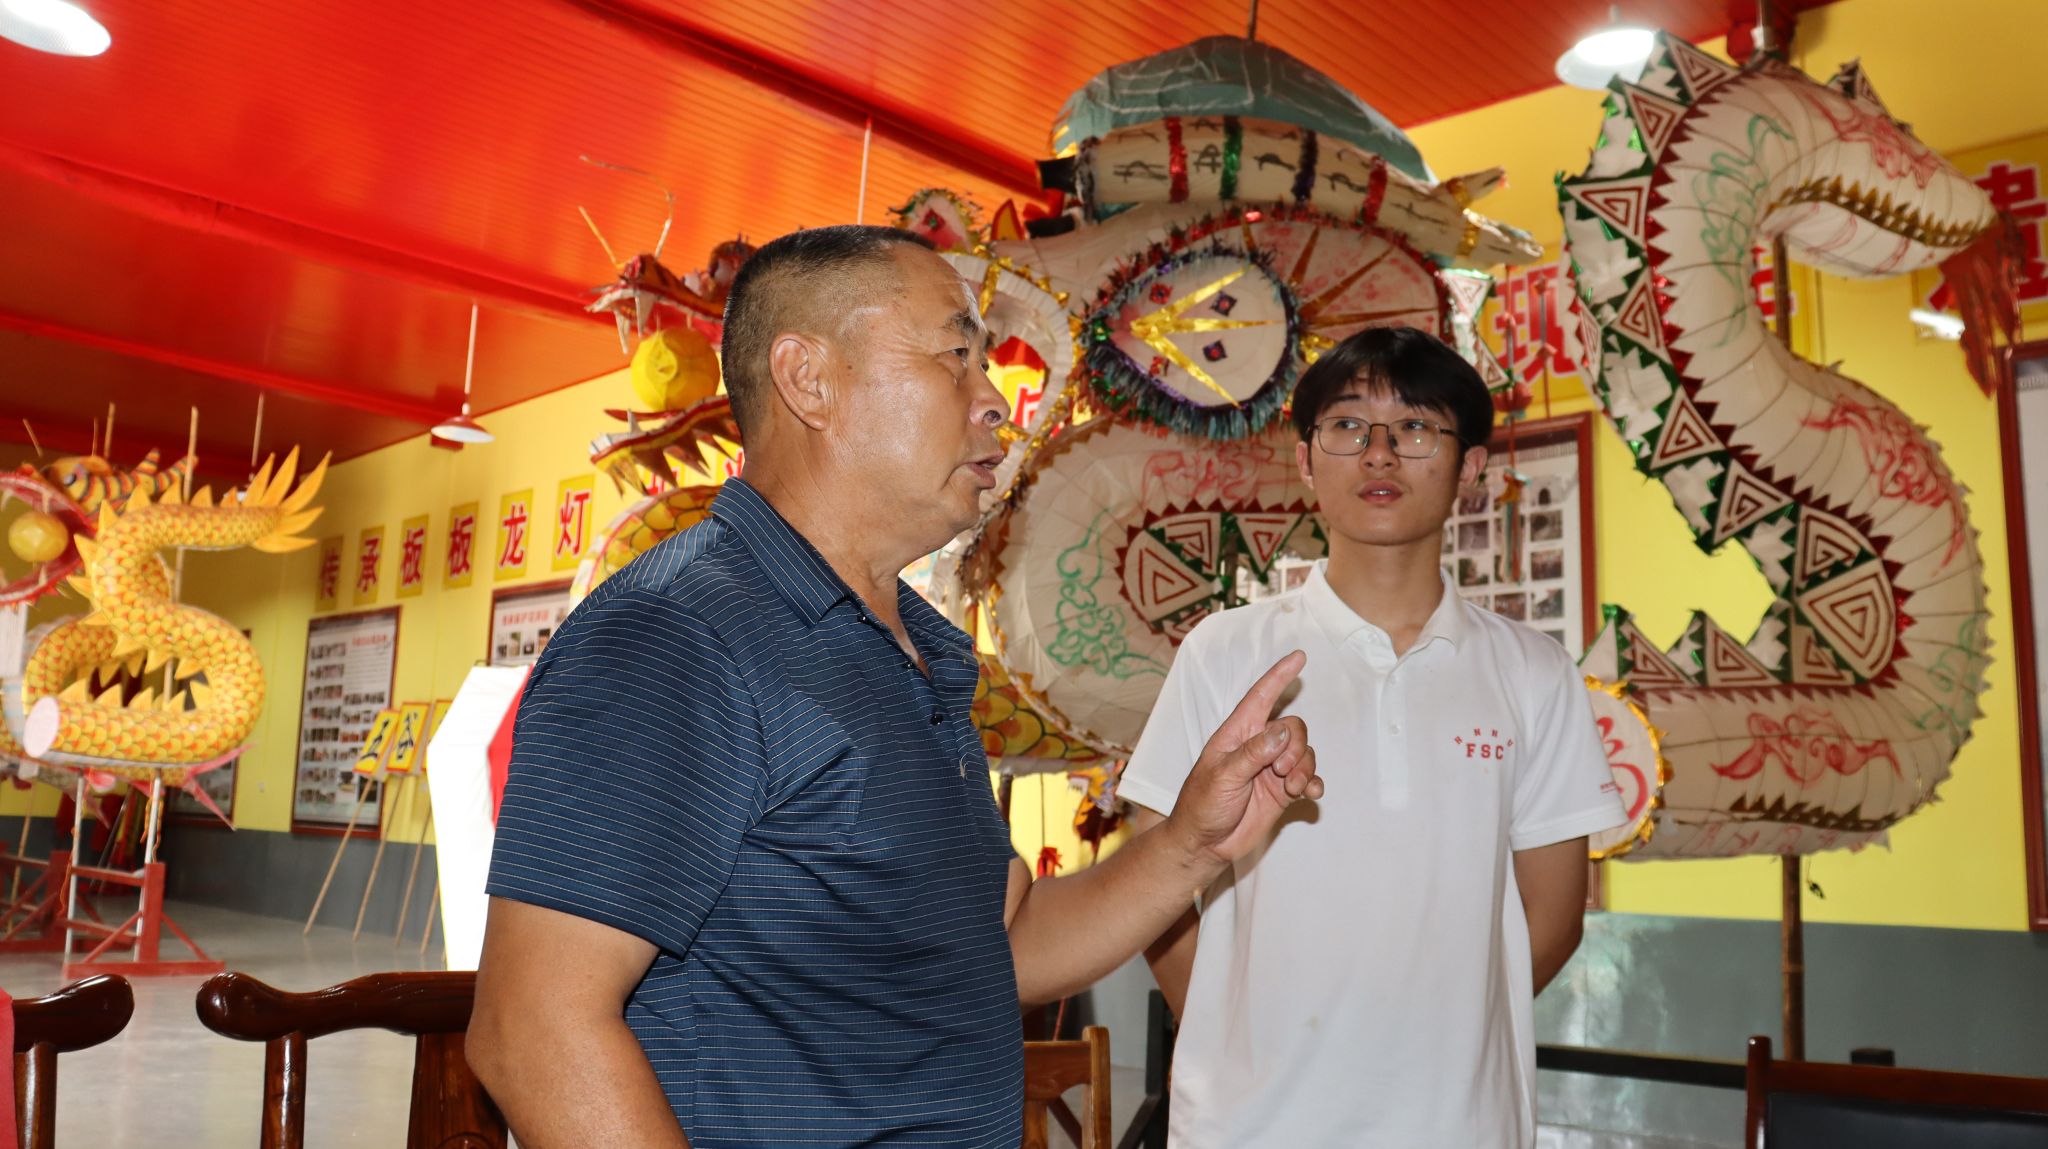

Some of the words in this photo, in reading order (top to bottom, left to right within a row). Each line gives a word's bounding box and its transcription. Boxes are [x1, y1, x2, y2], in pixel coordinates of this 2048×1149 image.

[318, 488, 592, 598] 传承板板龙灯
[1466, 743, 1504, 760] FSC
